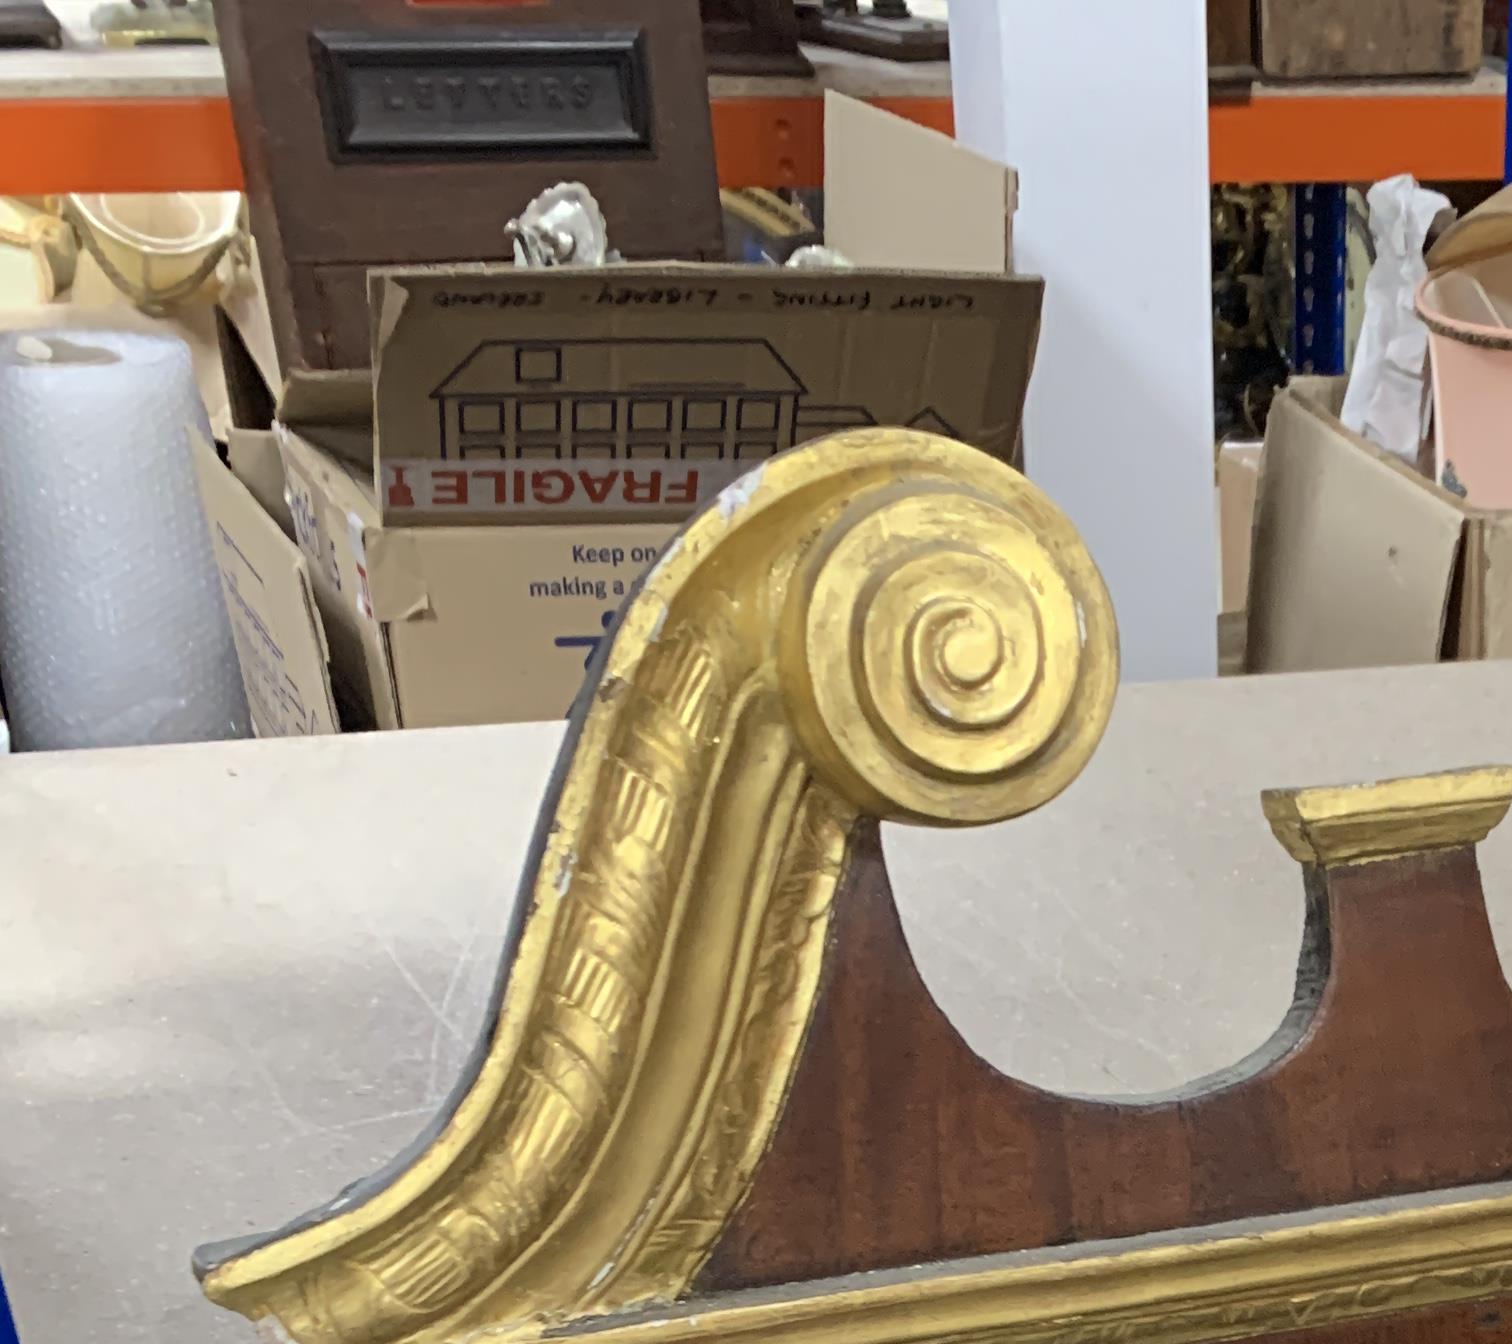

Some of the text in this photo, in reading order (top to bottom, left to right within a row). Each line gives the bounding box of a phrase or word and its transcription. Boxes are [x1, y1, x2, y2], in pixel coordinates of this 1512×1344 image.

[383, 76, 593, 112] LETTERS
[773, 290, 871, 310] FITTING
[430, 469, 699, 505] FRAGILE
[572, 544, 656, 567] Keep on
[529, 576, 607, 600] making
[612, 582, 624, 595] a
